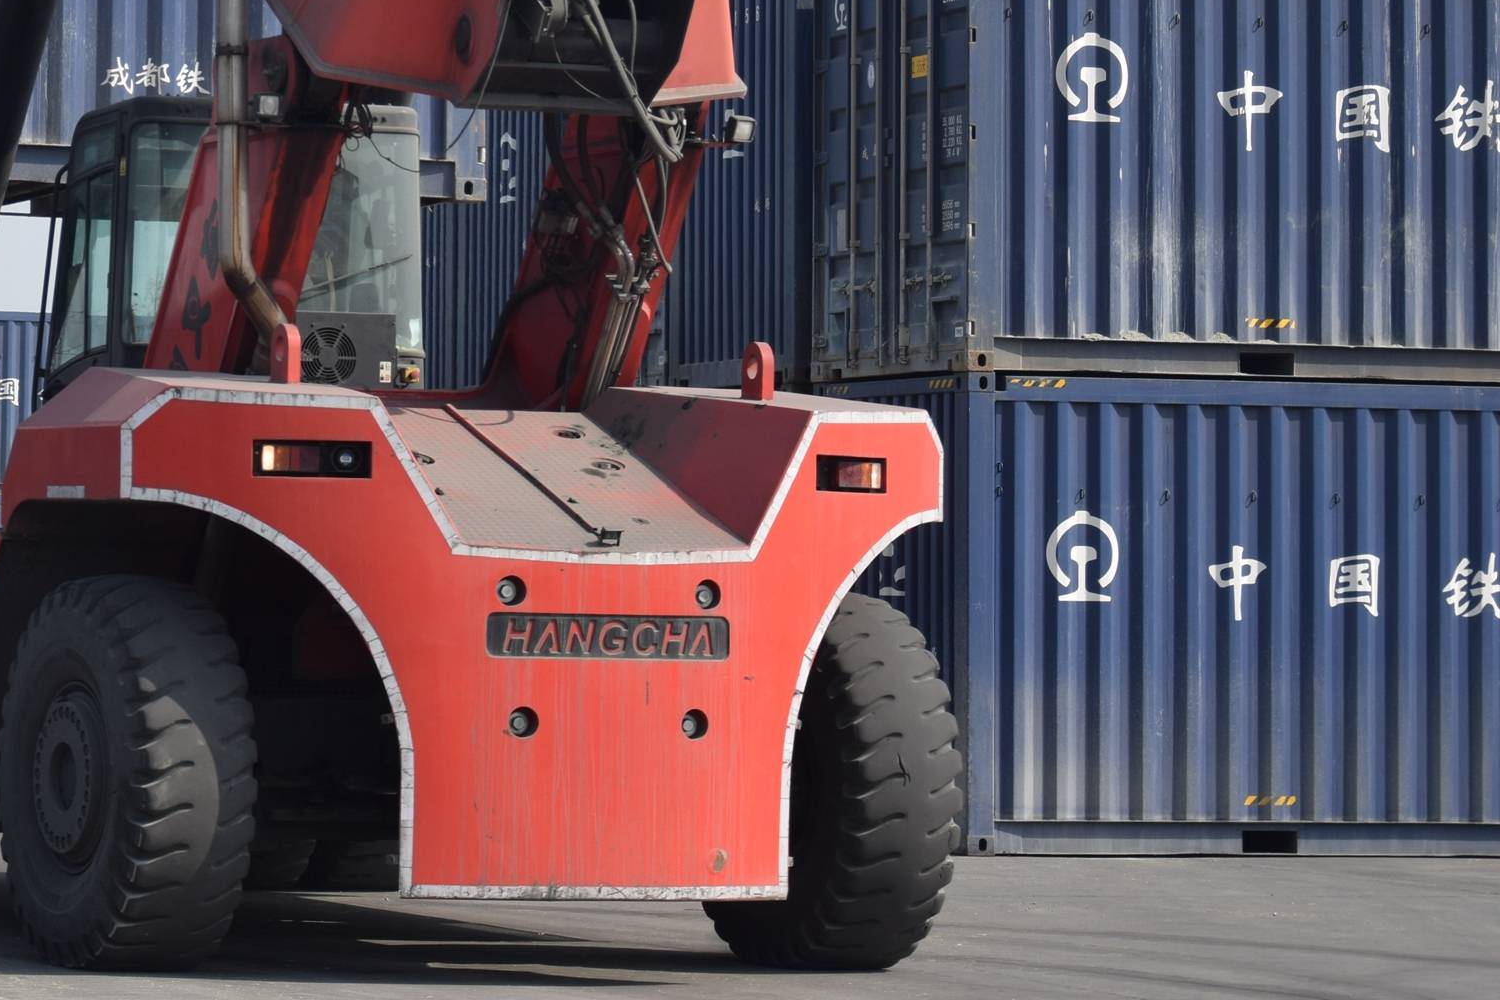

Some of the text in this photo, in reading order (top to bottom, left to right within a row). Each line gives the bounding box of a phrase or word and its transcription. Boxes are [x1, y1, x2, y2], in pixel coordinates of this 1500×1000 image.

[1208, 544, 1500, 621] 中国铁
[502, 617, 714, 657] HANGCHA
